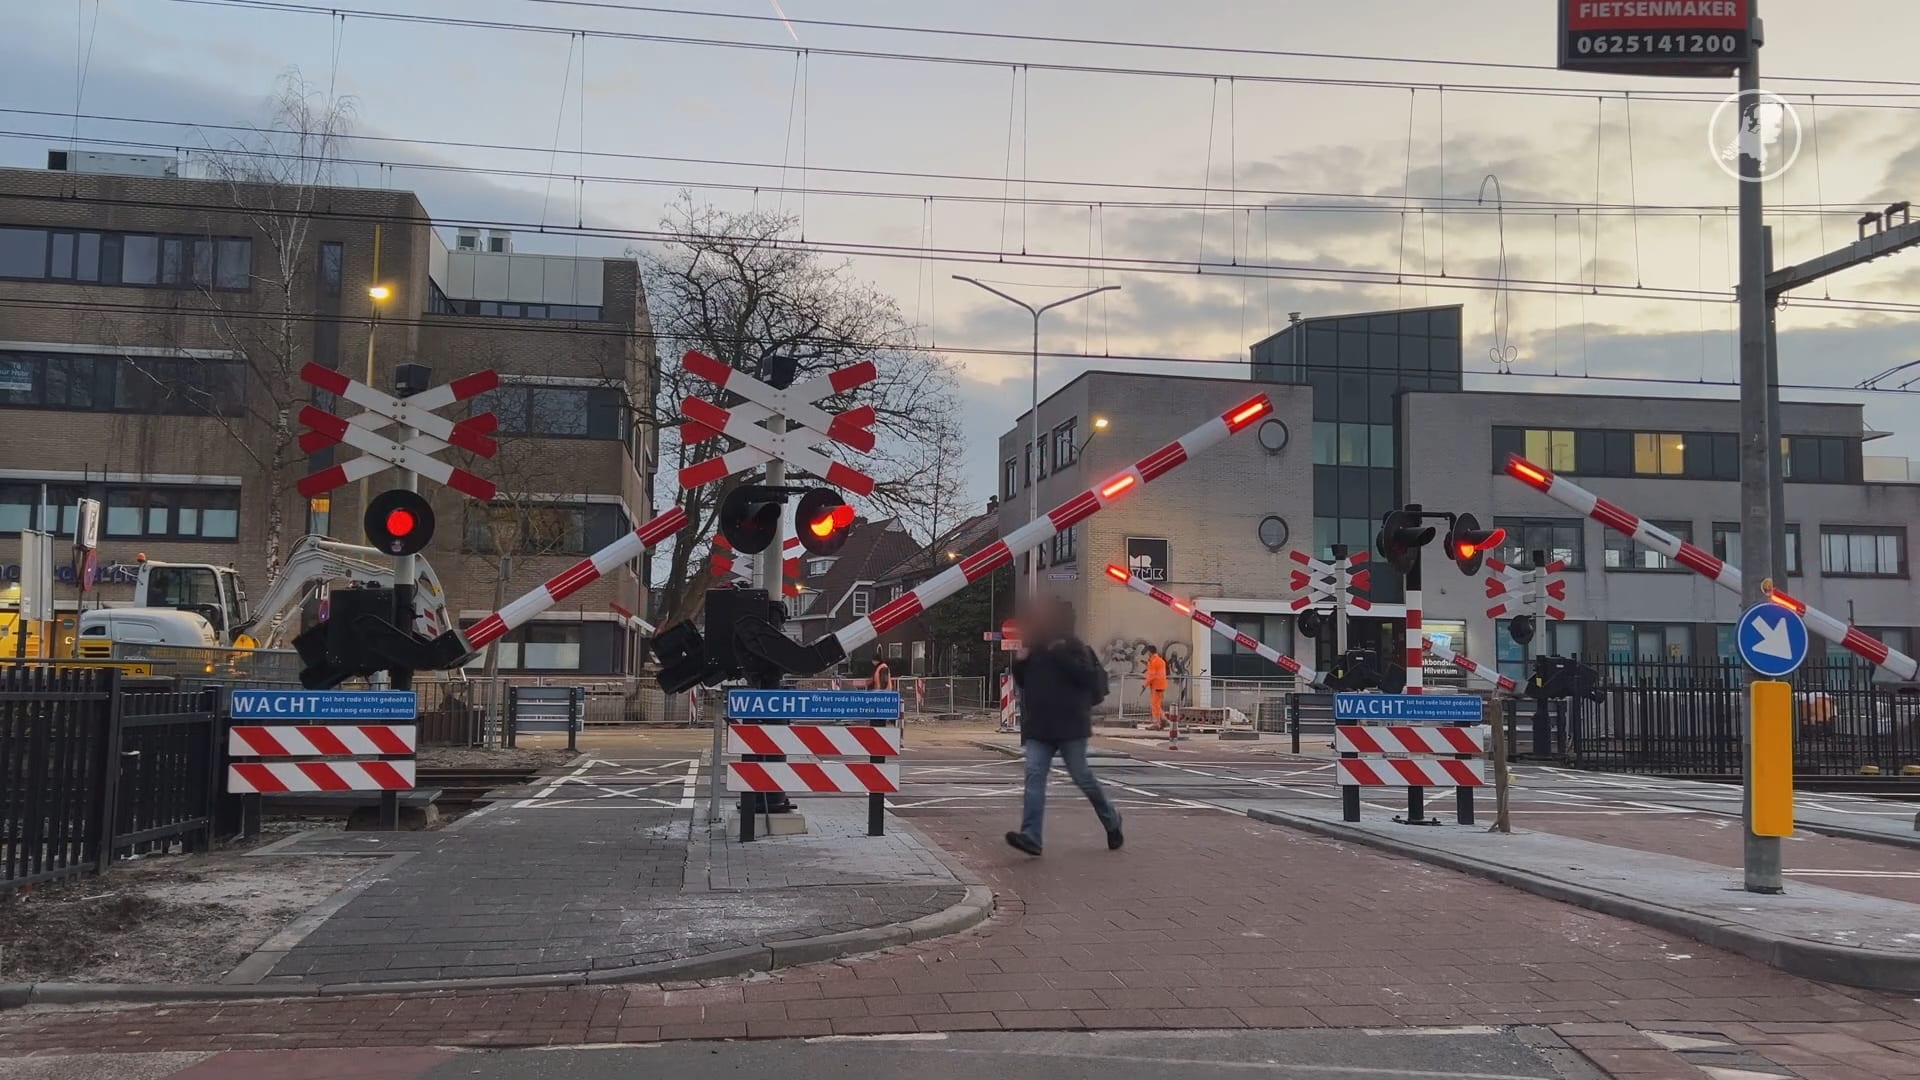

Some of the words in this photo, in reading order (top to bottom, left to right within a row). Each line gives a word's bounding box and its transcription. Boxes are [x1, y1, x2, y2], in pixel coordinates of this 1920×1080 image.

[1579, 1, 1737, 18] FIETSENMAKER
[1577, 35, 1736, 54] 0625141200
[1129, 554, 1152, 568] MR
[234, 696, 319, 713] WACHT
[730, 696, 810, 713] WACHT
[1337, 699, 1404, 714] WACHT
